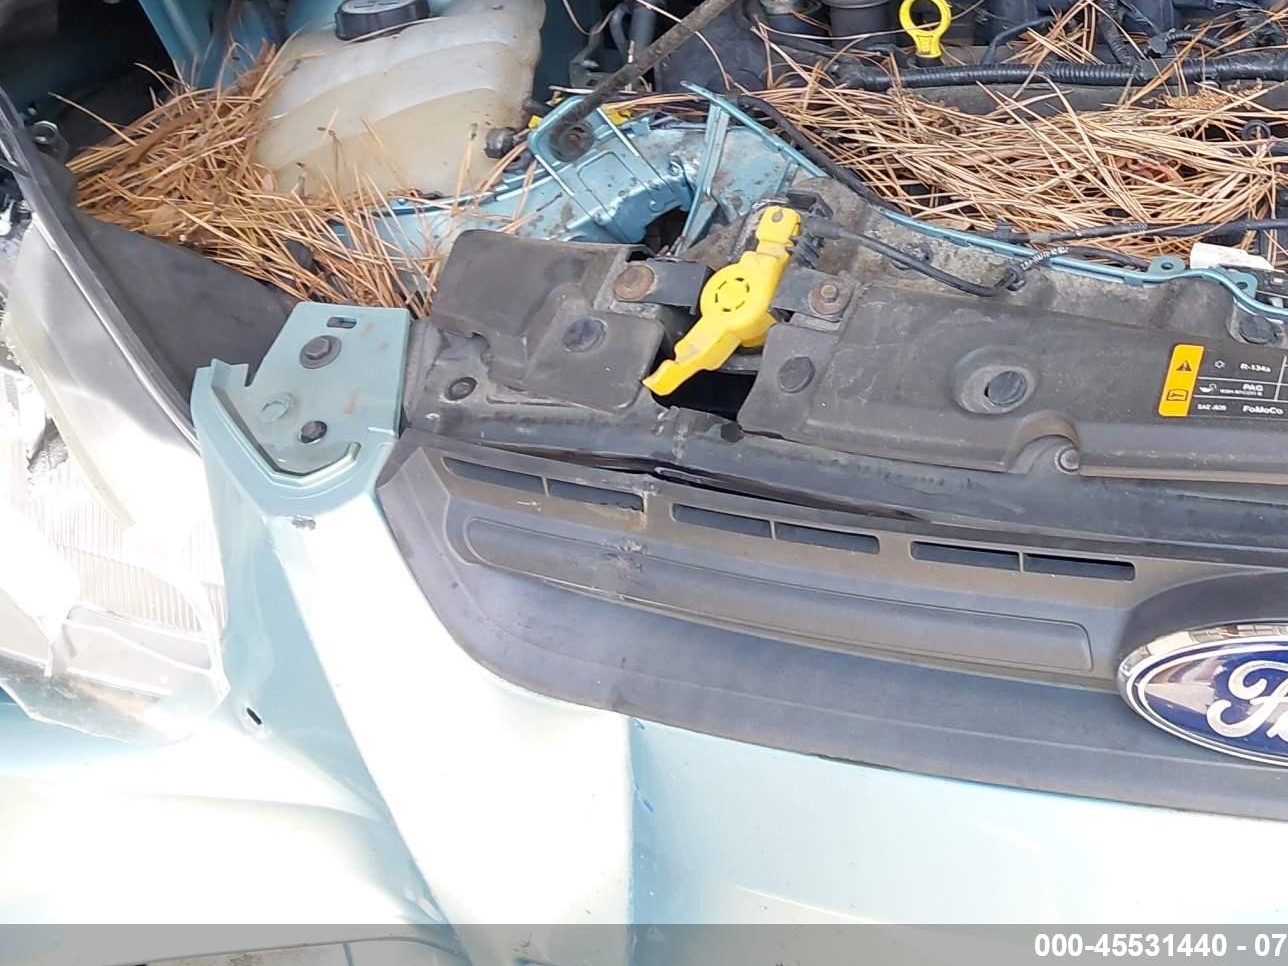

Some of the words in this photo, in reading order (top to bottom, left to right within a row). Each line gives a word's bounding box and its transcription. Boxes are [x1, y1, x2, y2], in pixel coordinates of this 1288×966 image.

[1240, 362, 1271, 373] R-134a
[1243, 383, 1265, 392] PAG
[1242, 405, 1284, 415] FoMoCo
